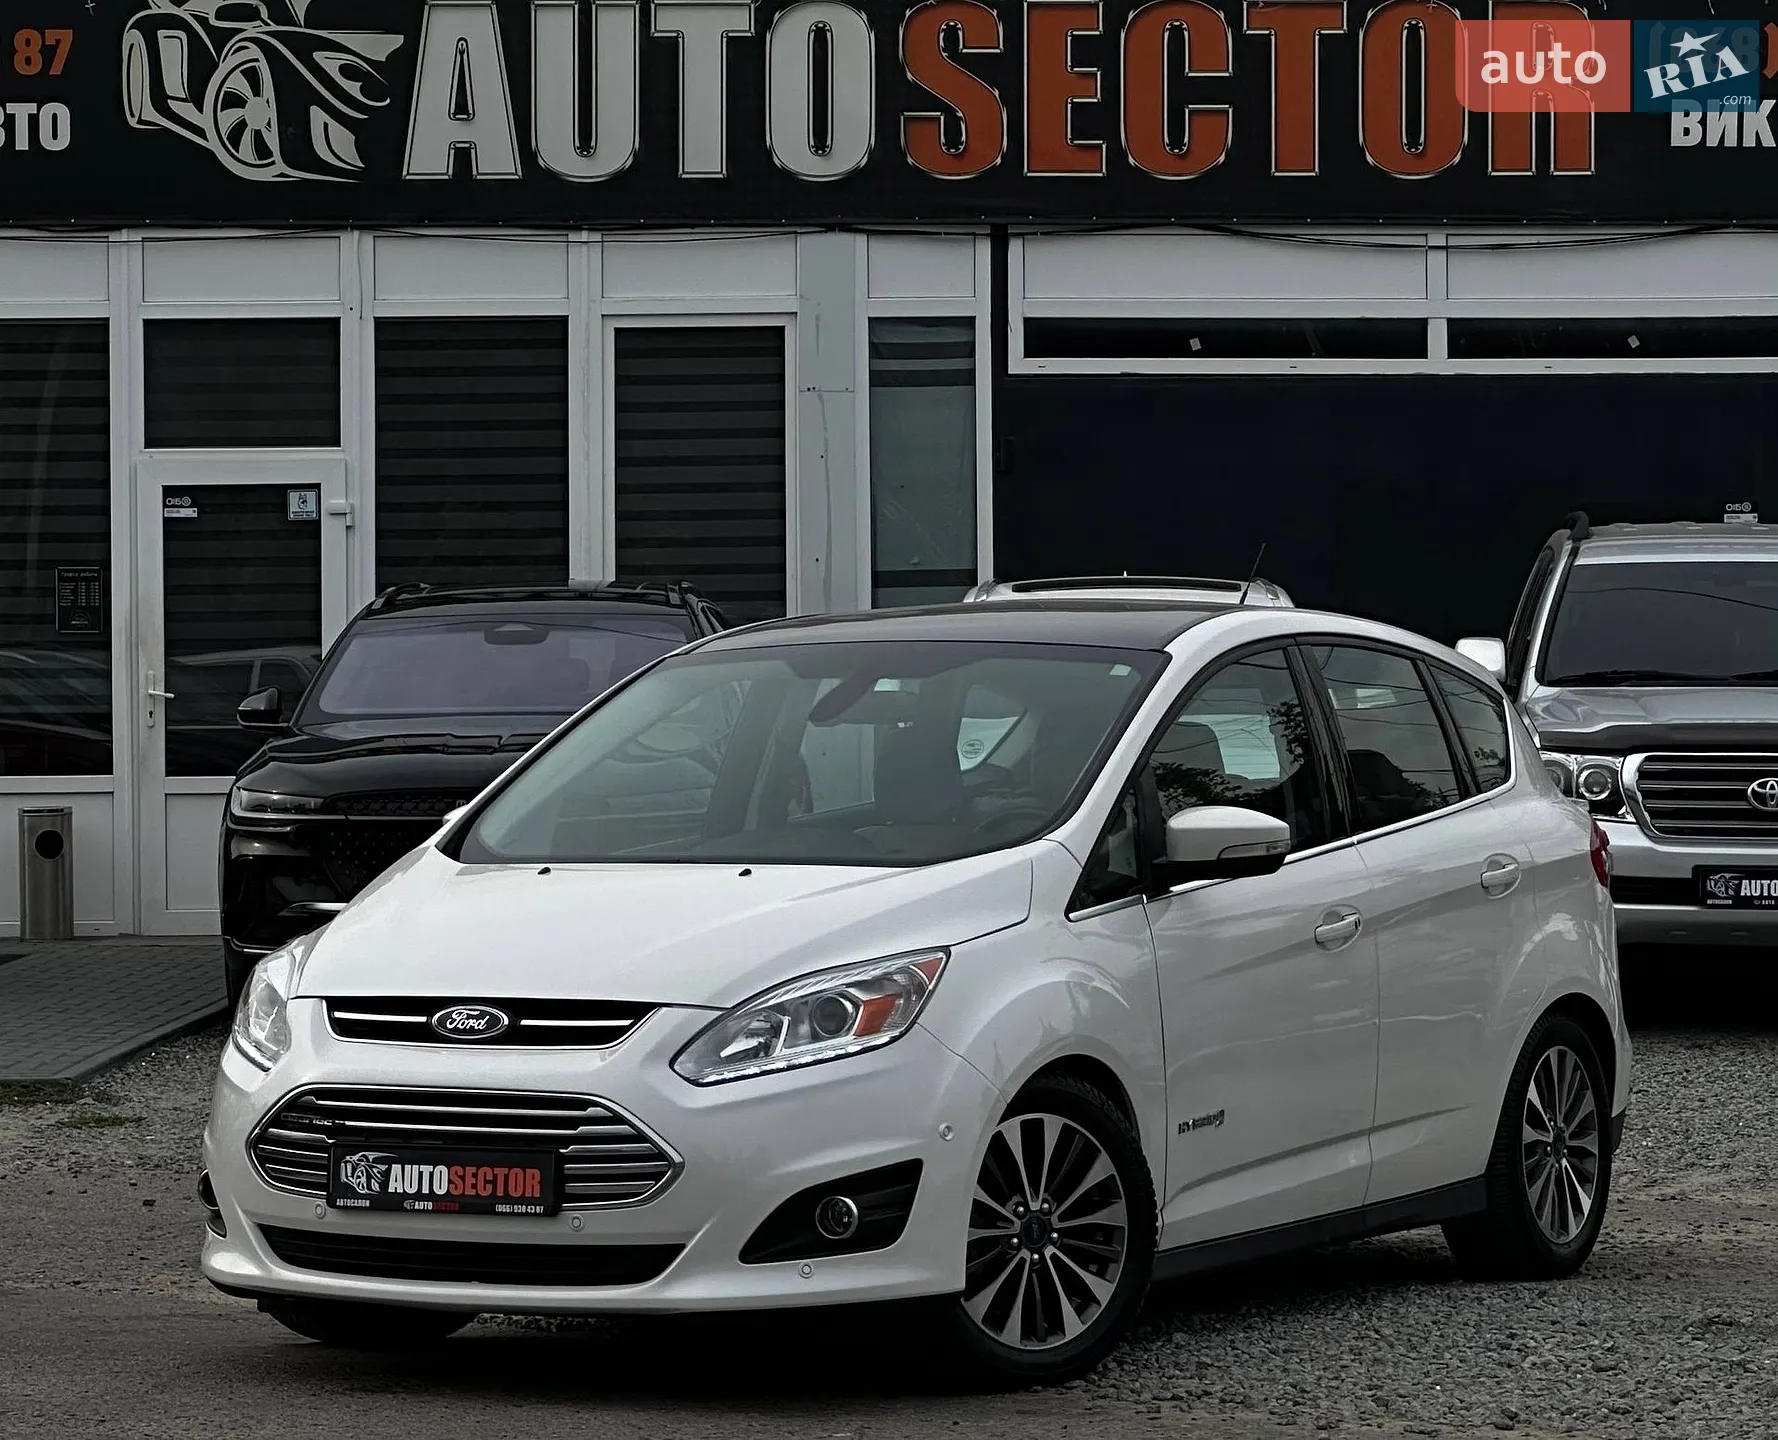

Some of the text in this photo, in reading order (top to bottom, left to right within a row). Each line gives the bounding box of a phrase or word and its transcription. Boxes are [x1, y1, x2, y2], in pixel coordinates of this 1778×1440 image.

[14, 28, 73, 75] 87
[0, 102, 70, 151] ТО
[1670, 99, 1778, 147] ВИК
[447, 1009, 490, 1029] Ford
[388, 1163, 541, 1198] AUTOSECTOR
